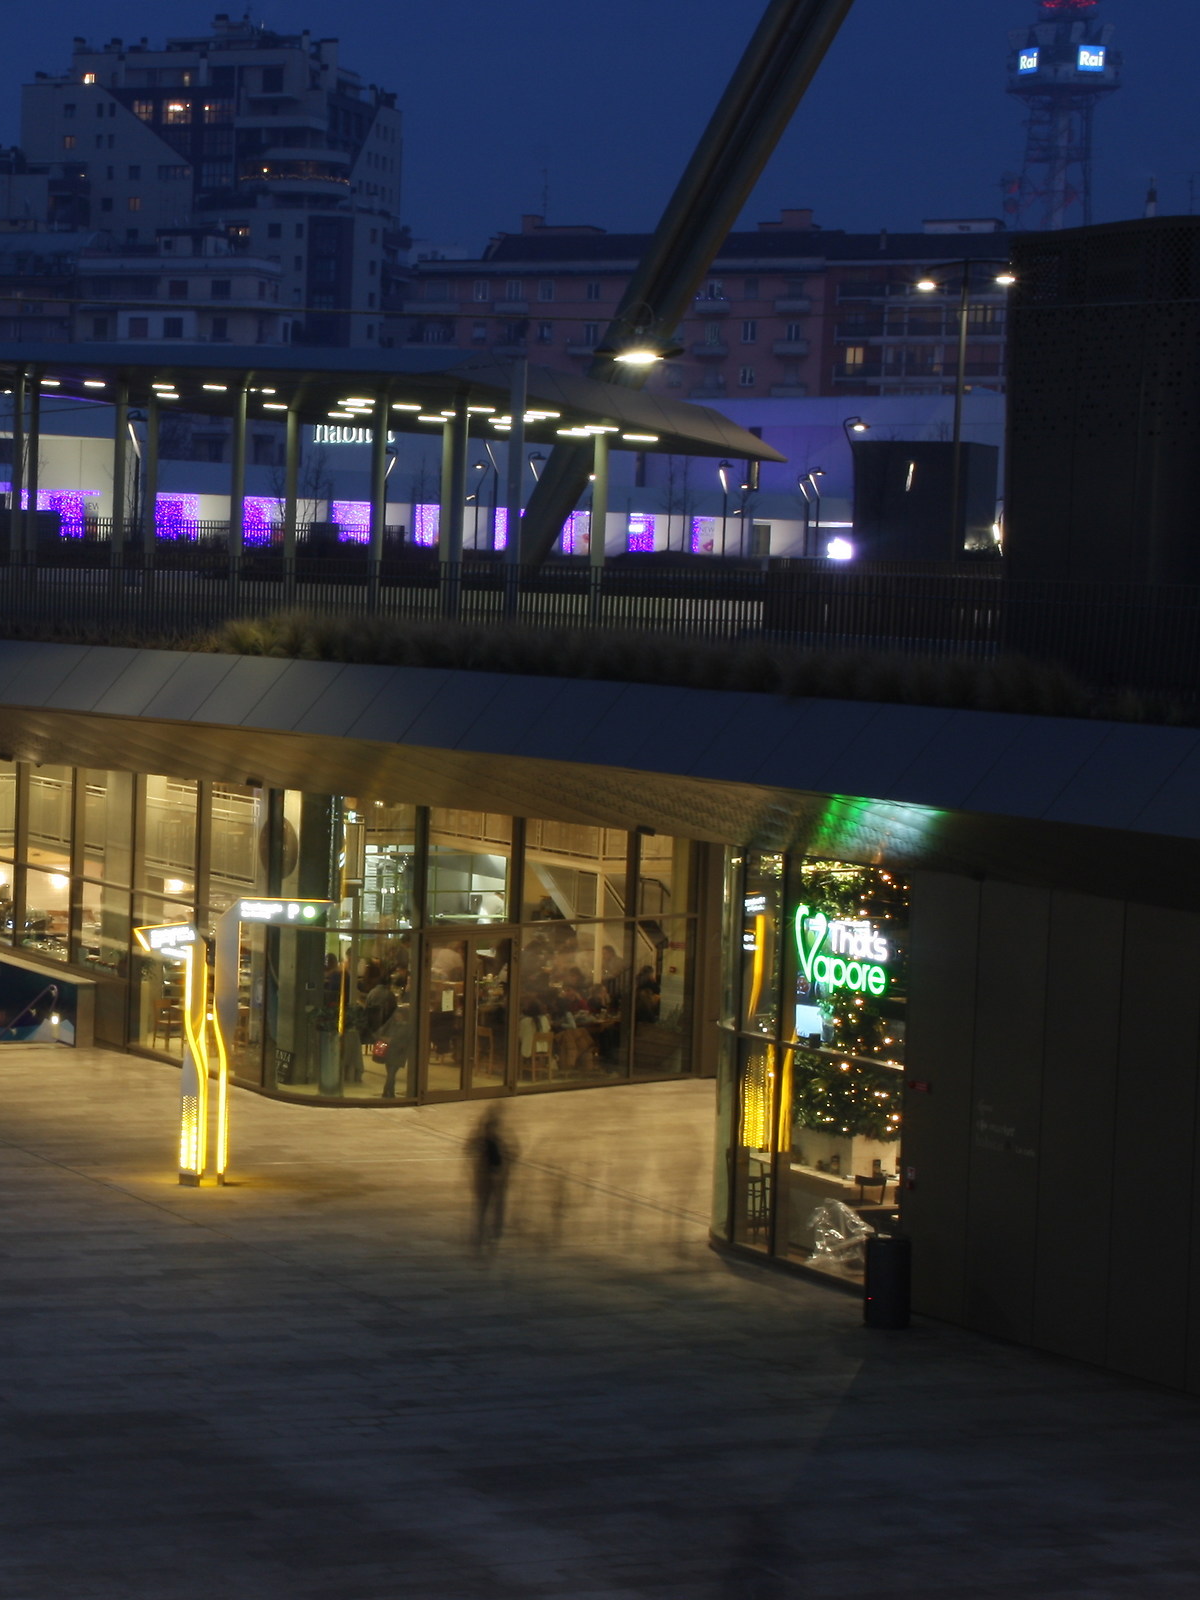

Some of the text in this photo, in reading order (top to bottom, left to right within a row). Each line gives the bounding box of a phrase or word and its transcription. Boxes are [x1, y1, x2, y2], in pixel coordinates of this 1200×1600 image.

[1019, 52, 1038, 70] Rai
[1079, 51, 1104, 67] Rai
[795, 904, 886, 996] Vapore
[828, 922, 888, 962] That's
